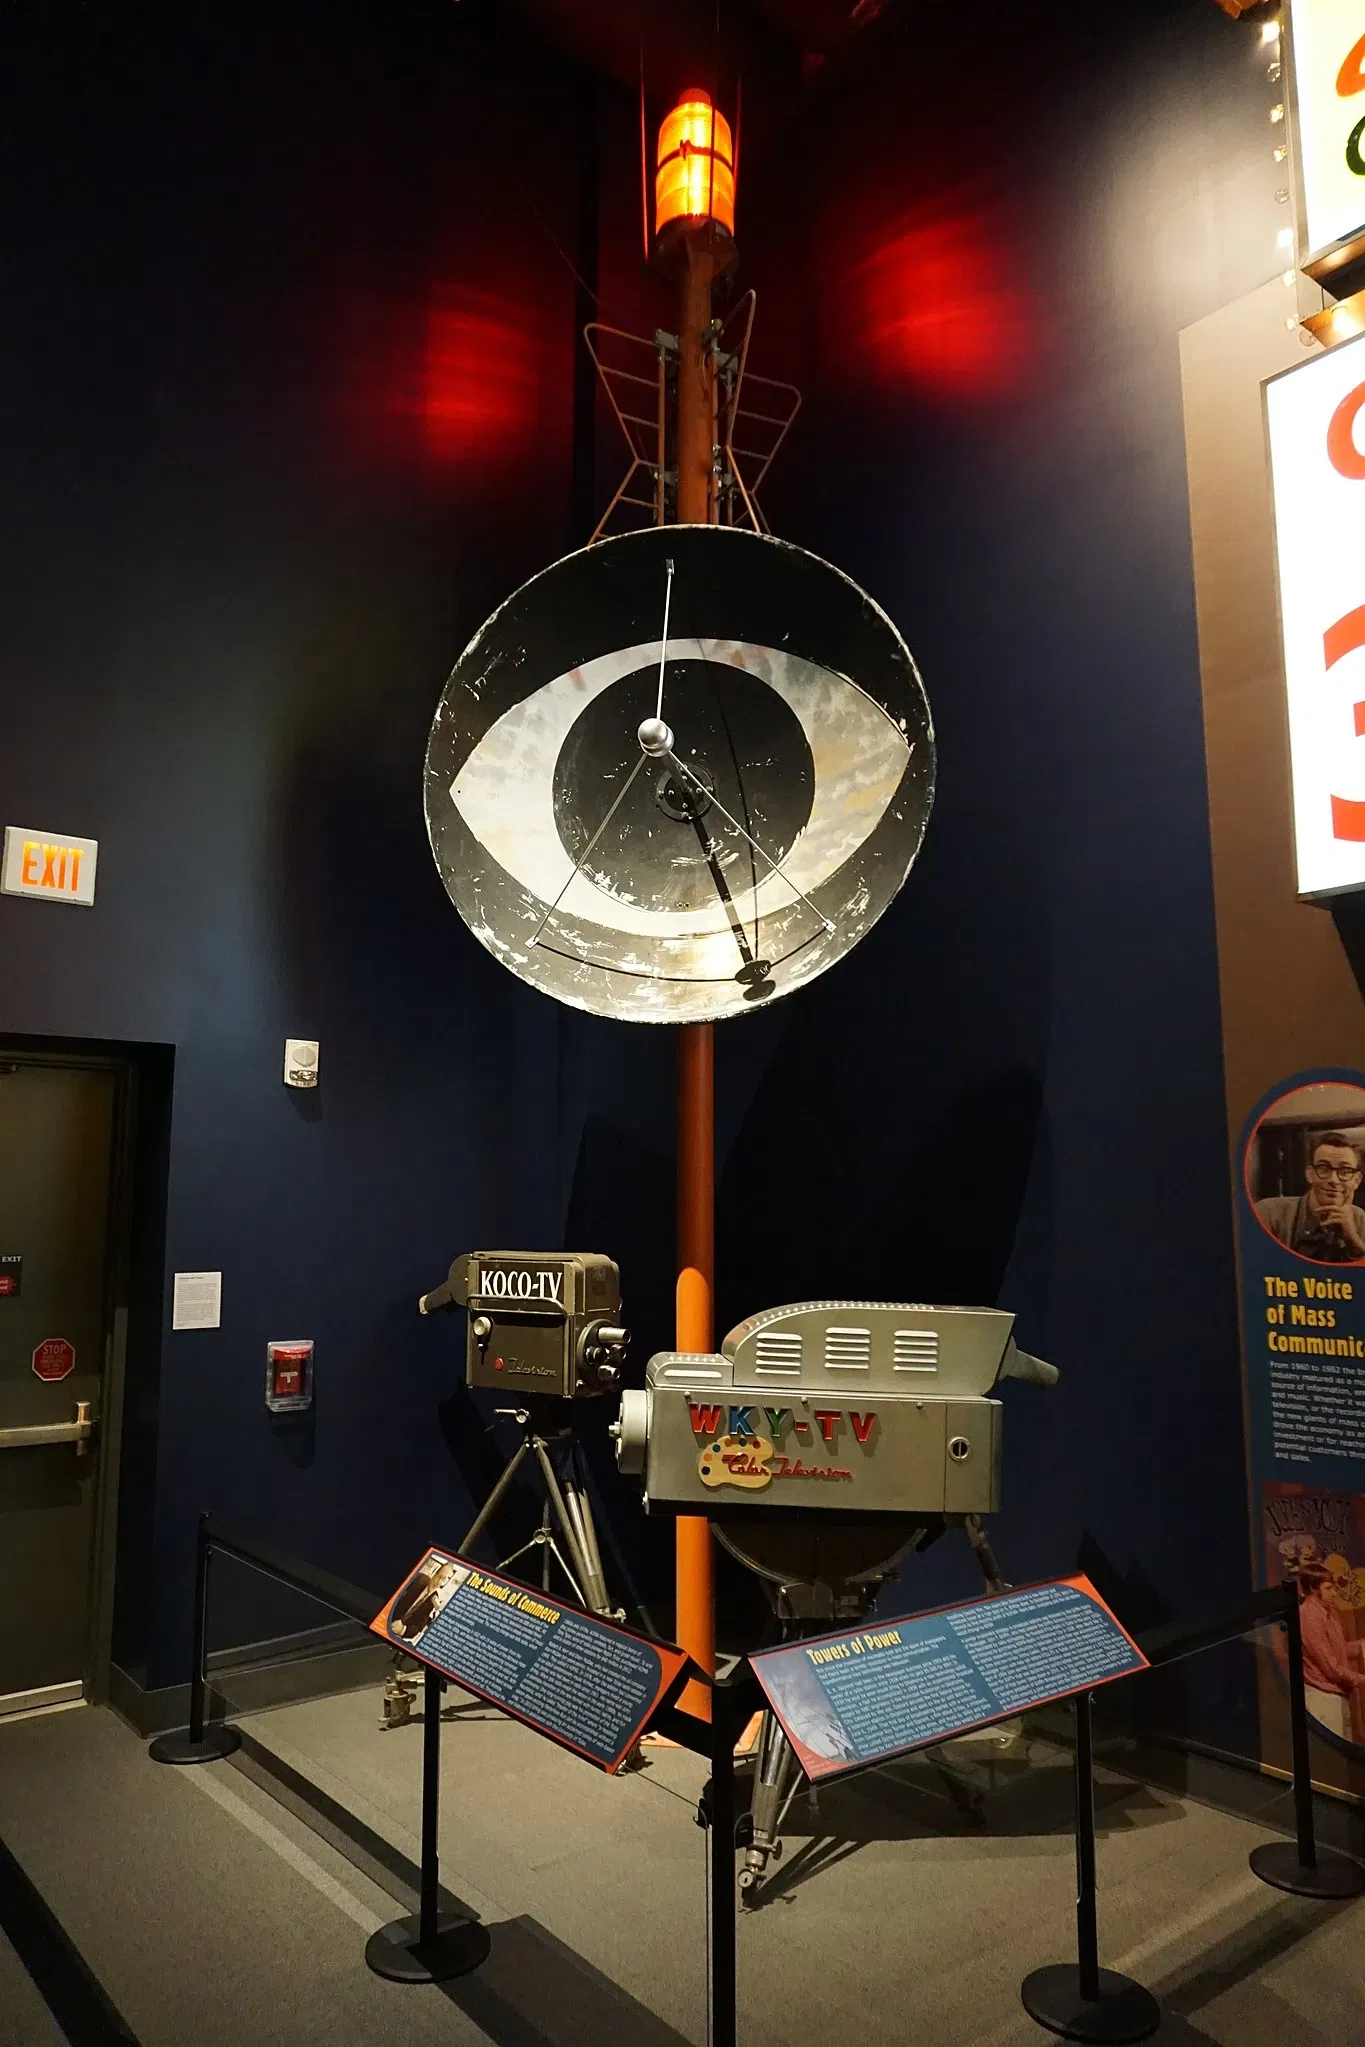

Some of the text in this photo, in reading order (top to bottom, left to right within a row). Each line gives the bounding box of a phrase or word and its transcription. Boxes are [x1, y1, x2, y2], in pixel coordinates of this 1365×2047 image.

[21, 841, 84, 892] EXIT
[481, 1270, 563, 1300] KOCO-TV
[1264, 1277, 1353, 1300] The Voice
[1266, 1304, 1336, 1327] of Mass
[43, 1344, 67, 1355] STOP
[1267, 1331, 1365, 1358] Communic
[1270, 1361, 1289, 1369] From
[1342, 1367, 1356, 1375] the
[1302, 1374, 1334, 1384] matured
[1271, 1382, 1296, 1390] source
[687, 1401, 877, 1442] WKY-TV
[1321, 1406, 1334, 1414] the
[1295, 1423, 1309, 1431] the
[721, 1453, 854, 1479] Color Television
[466, 1572, 561, 1625] The Sounds of Commerce
[806, 1631, 902, 1665] Towers of Power
